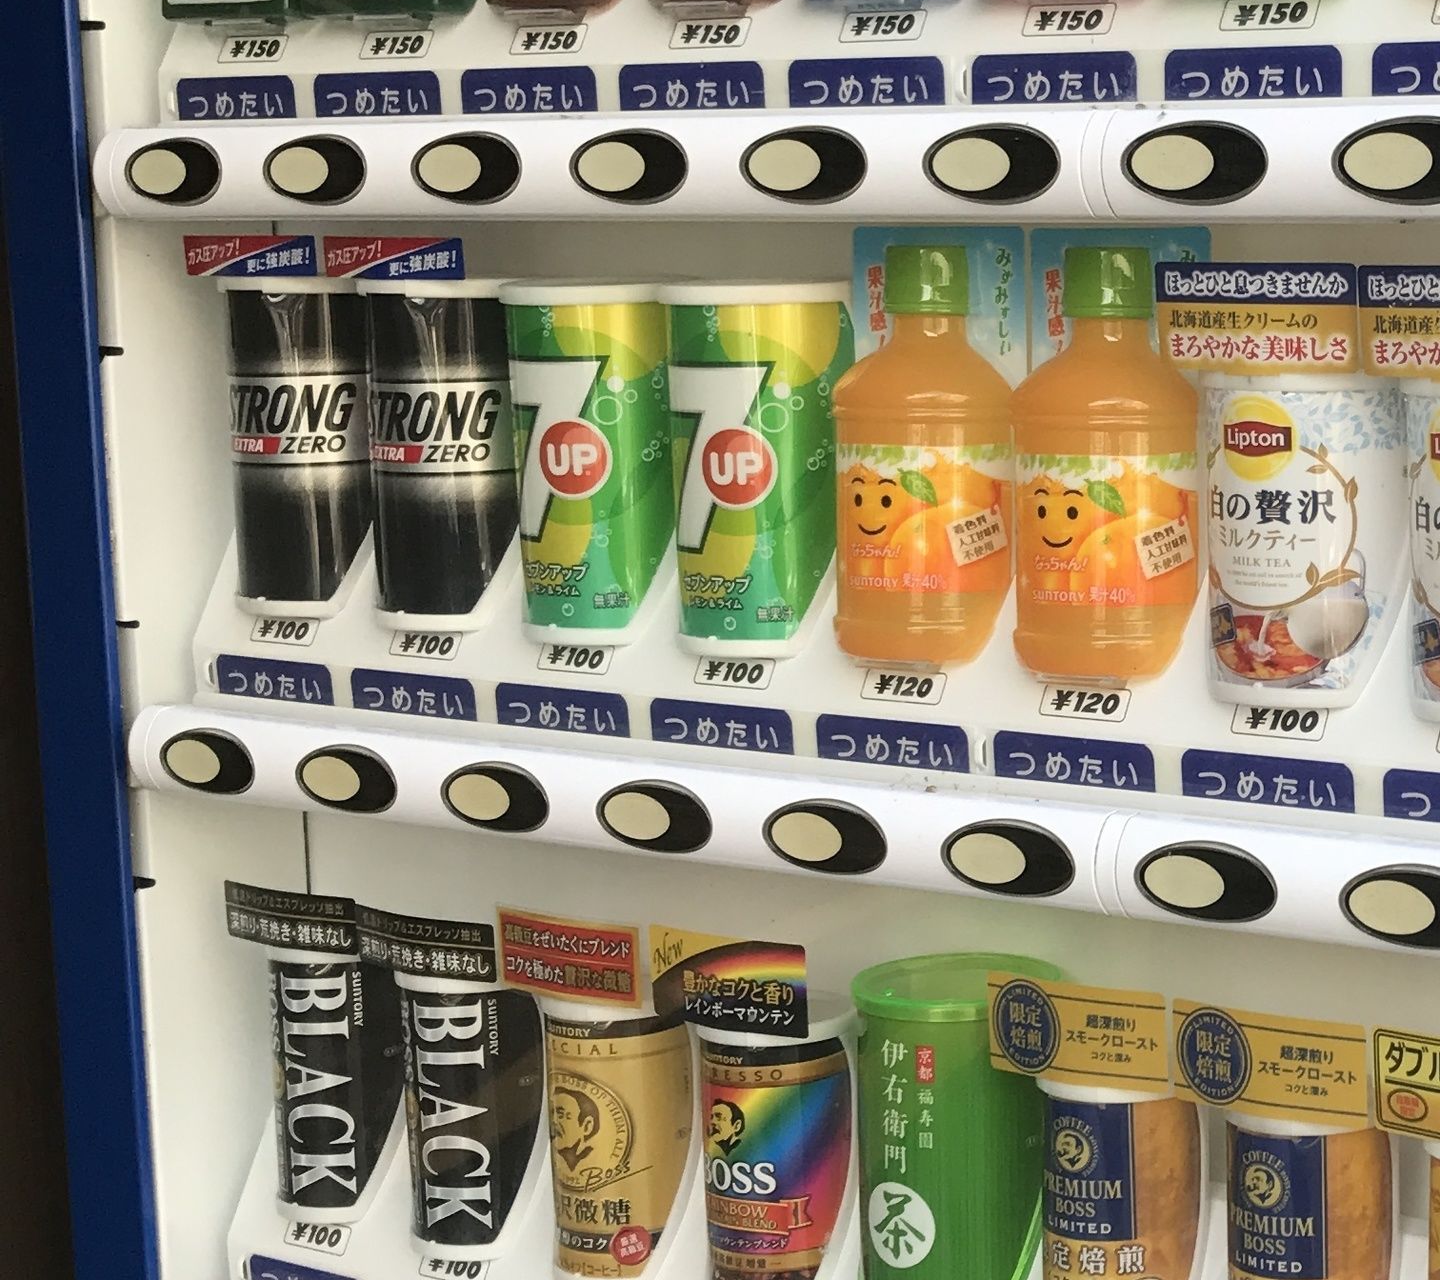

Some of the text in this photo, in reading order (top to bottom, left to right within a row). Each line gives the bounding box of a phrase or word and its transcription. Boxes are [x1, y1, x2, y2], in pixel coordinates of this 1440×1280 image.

[1035, 11, 1104, 30] ¥150
[681, 25, 740, 45] ¥150
[230, 40, 280, 58] ¥150
[188, 92, 283, 118] つめたい
[1167, 272, 1348, 297] ほっとひと息つきませんか
[1169, 311, 1318, 330] 北海道産生クリームの
[1169, 334, 1348, 362] まろやかな美味しさ
[281, 435, 346, 454] ZERO
[1228, 428, 1284, 448] Lipton
[547, 442, 592, 477] UP
[1217, 525, 1316, 550] ミルクティー
[1233, 556, 1291, 567] MILK TEA
[260, 621, 309, 641] ¥100
[547, 647, 604, 668] ¥100
[1053, 690, 1120, 714] ¥120
[1197, 771, 1336, 807] つめたい
[653, 936, 683, 973] New
[683, 970, 794, 1005] 豊かなコクと香り
[685, 997, 794, 1025] レインボーマウンテン
[1010, 1003, 1041, 1027] 限定
[1066, 1031, 1158, 1052] スモークロースト
[281, 973, 357, 1195] BLACK
[881, 1040, 908, 1174] 伊右衛門
[705, 1159, 776, 1194] BOSS
[1055, 1196, 1096, 1217] BOSS
[872, 1191, 924, 1259] 茶
[1046, 1215, 1111, 1234] LIMITED
